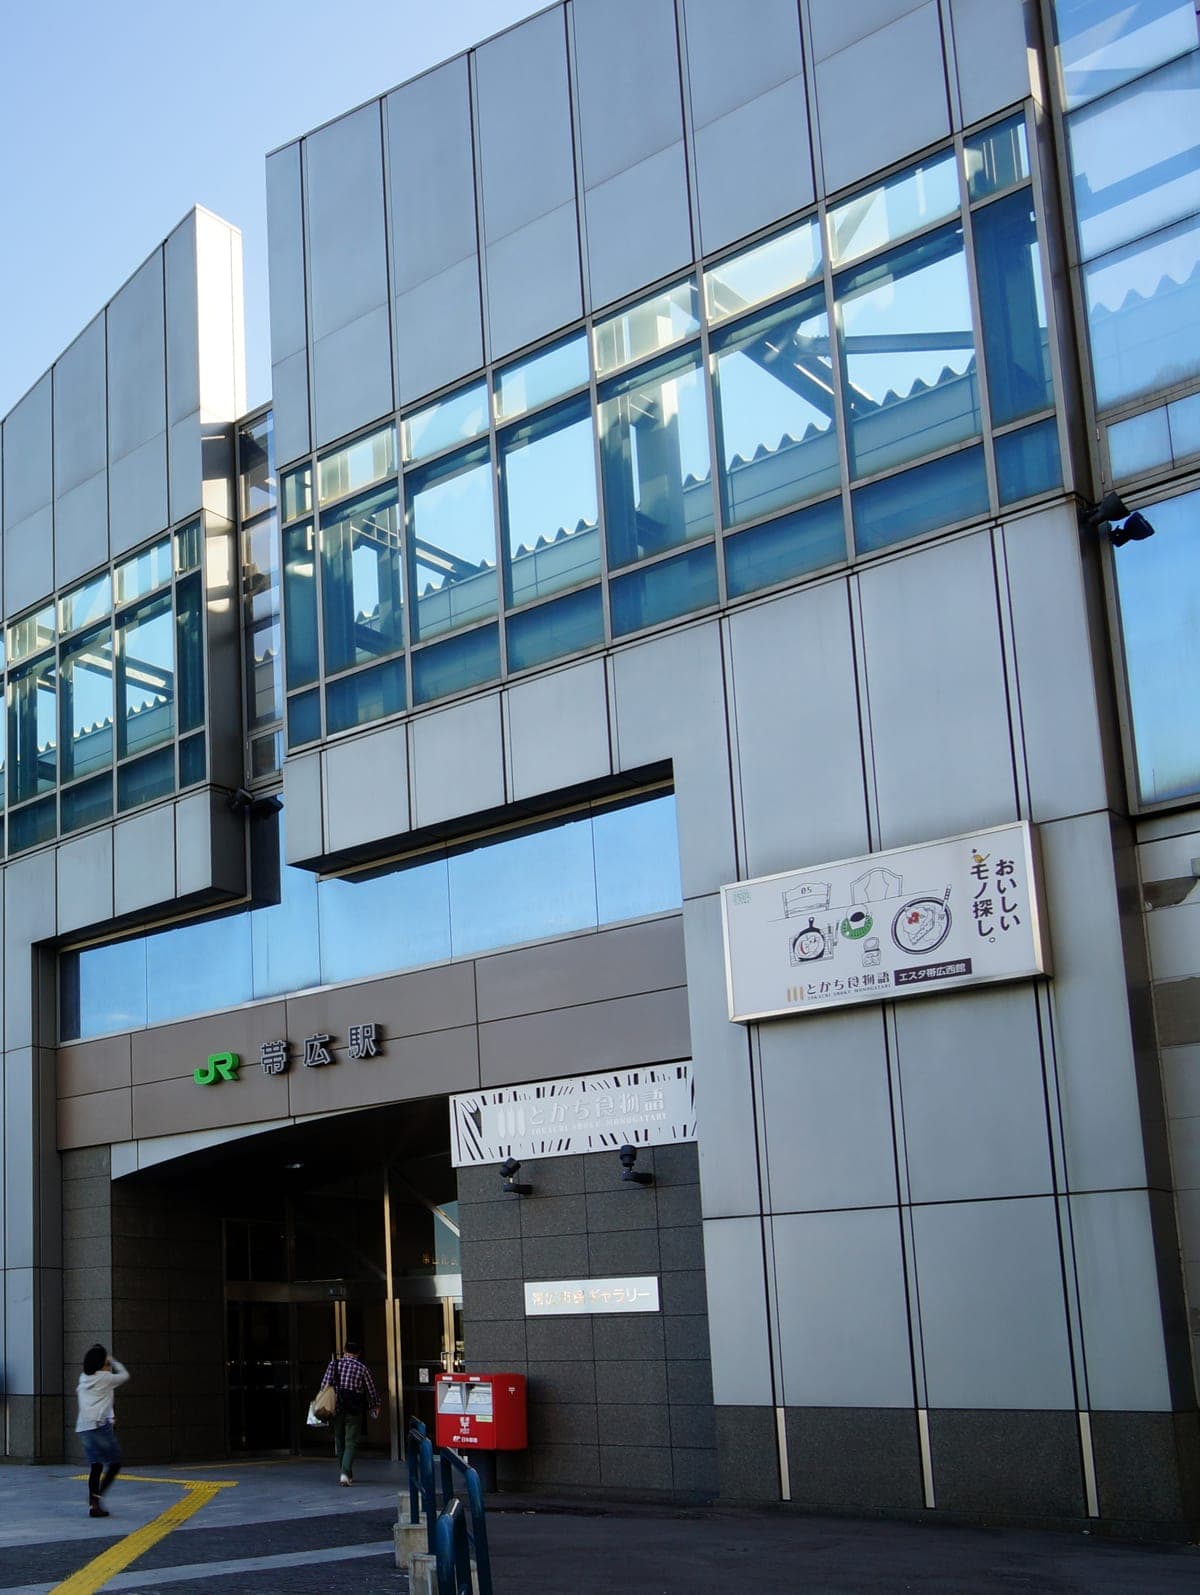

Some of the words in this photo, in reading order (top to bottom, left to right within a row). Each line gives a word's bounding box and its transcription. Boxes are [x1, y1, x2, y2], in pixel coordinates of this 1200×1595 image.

[970, 863, 996, 943] モノ探し。
[995, 859, 1021, 931] おいしい
[807, 971, 890, 995] とかち食物語
[899, 963, 967, 982] エスタ帯広西館
[194, 1052, 240, 1085] JR
[261, 1022, 385, 1075] 帯広駅
[530, 1088, 664, 1125] とかち食物語
